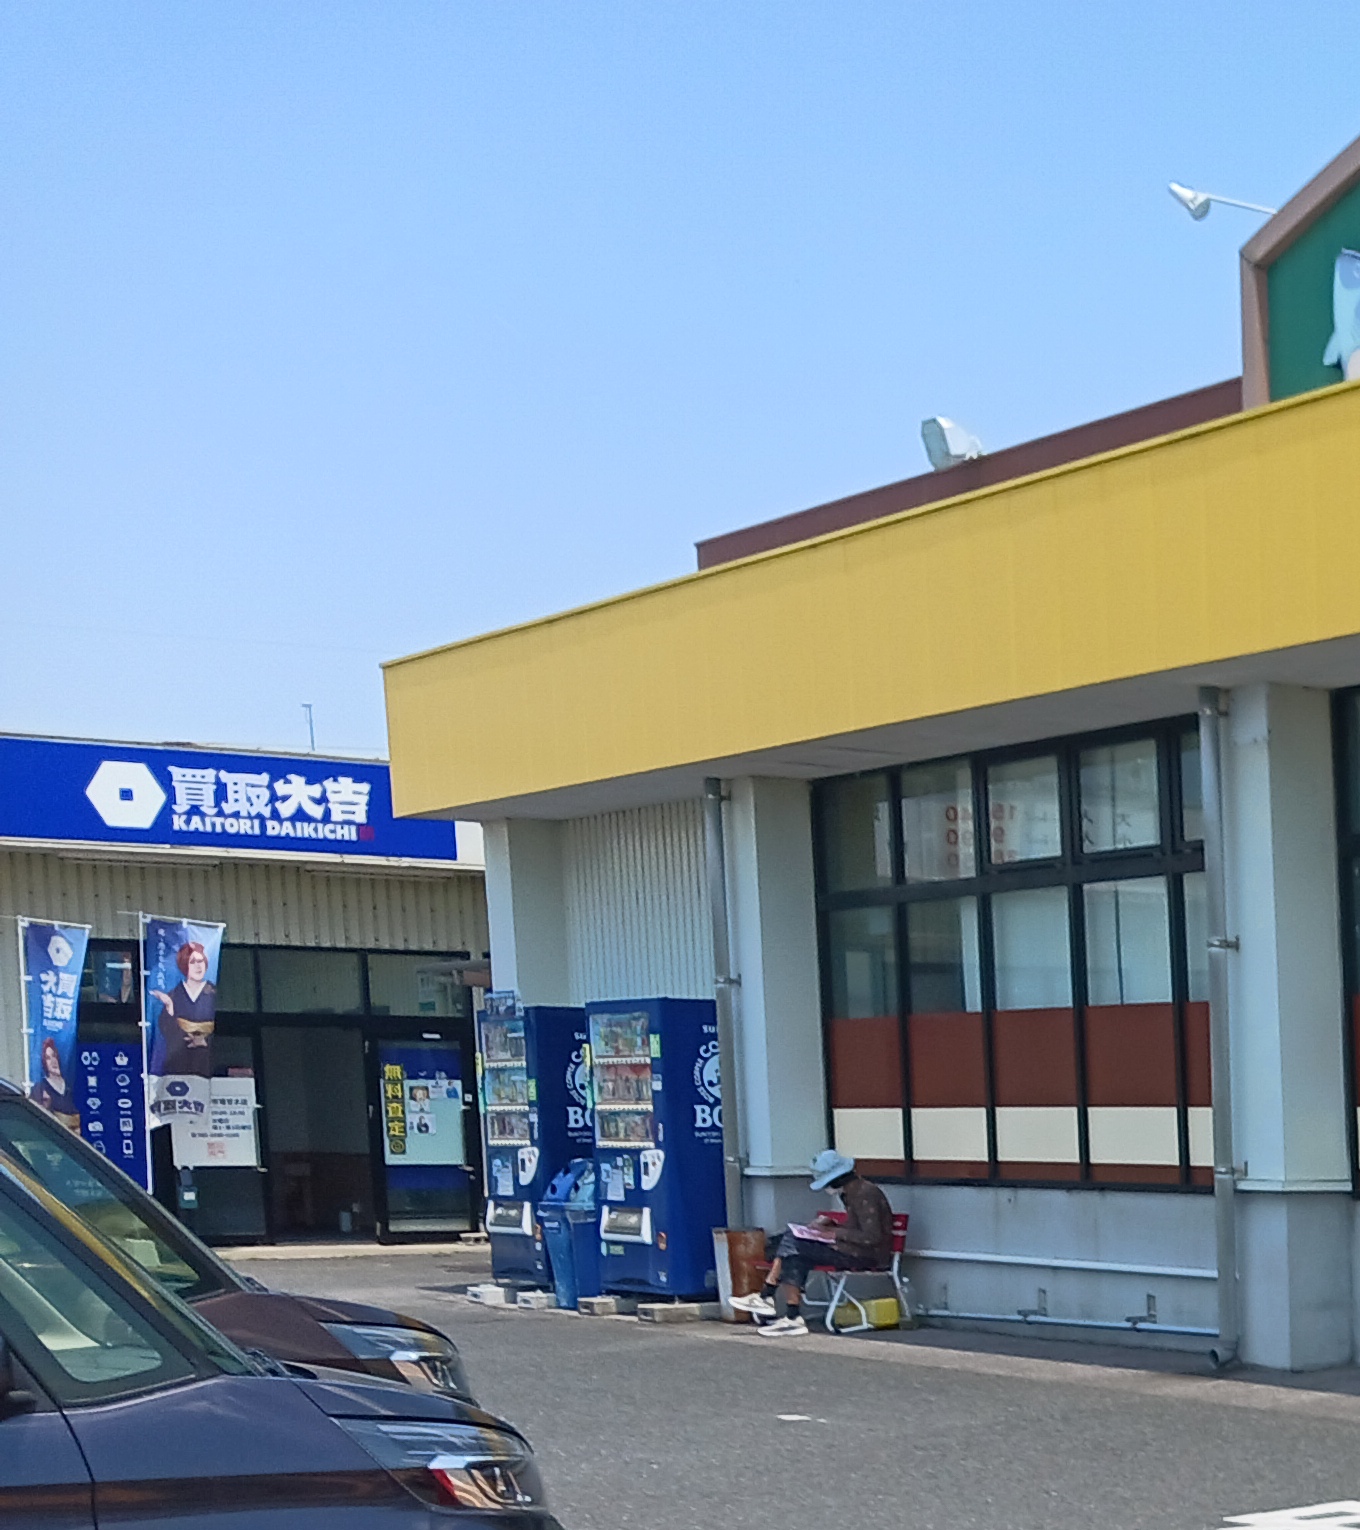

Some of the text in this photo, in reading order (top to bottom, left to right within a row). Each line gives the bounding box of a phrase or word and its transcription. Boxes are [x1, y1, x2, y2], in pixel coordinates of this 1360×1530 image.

[167, 765, 371, 824] 買取大吉
[172, 814, 358, 842] KAITORI DAIKICHI
[384, 1063, 406, 1136] 無料査定
